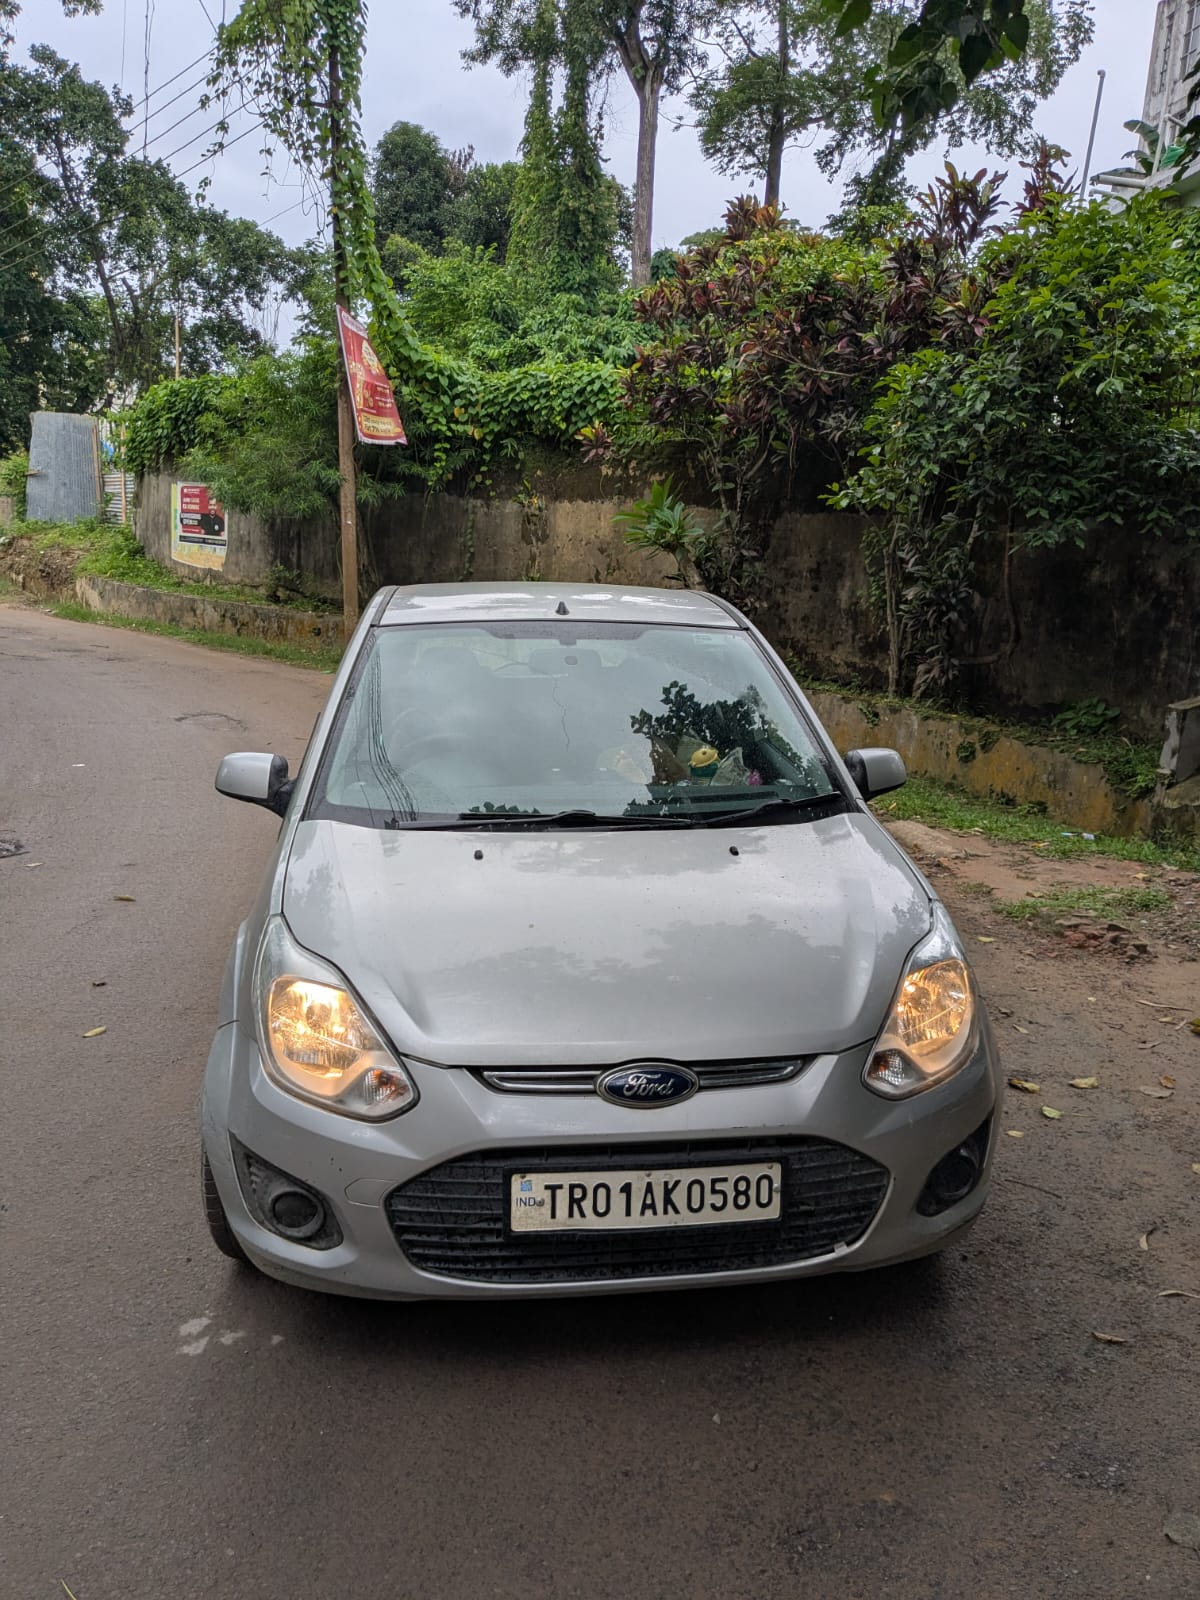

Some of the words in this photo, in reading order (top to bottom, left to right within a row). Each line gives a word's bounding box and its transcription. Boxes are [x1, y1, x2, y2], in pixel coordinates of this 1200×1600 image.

[623, 1073, 675, 1097] Ford
[515, 1196, 536, 1207] IND
[544, 1173, 774, 1220] TR01AK0580
